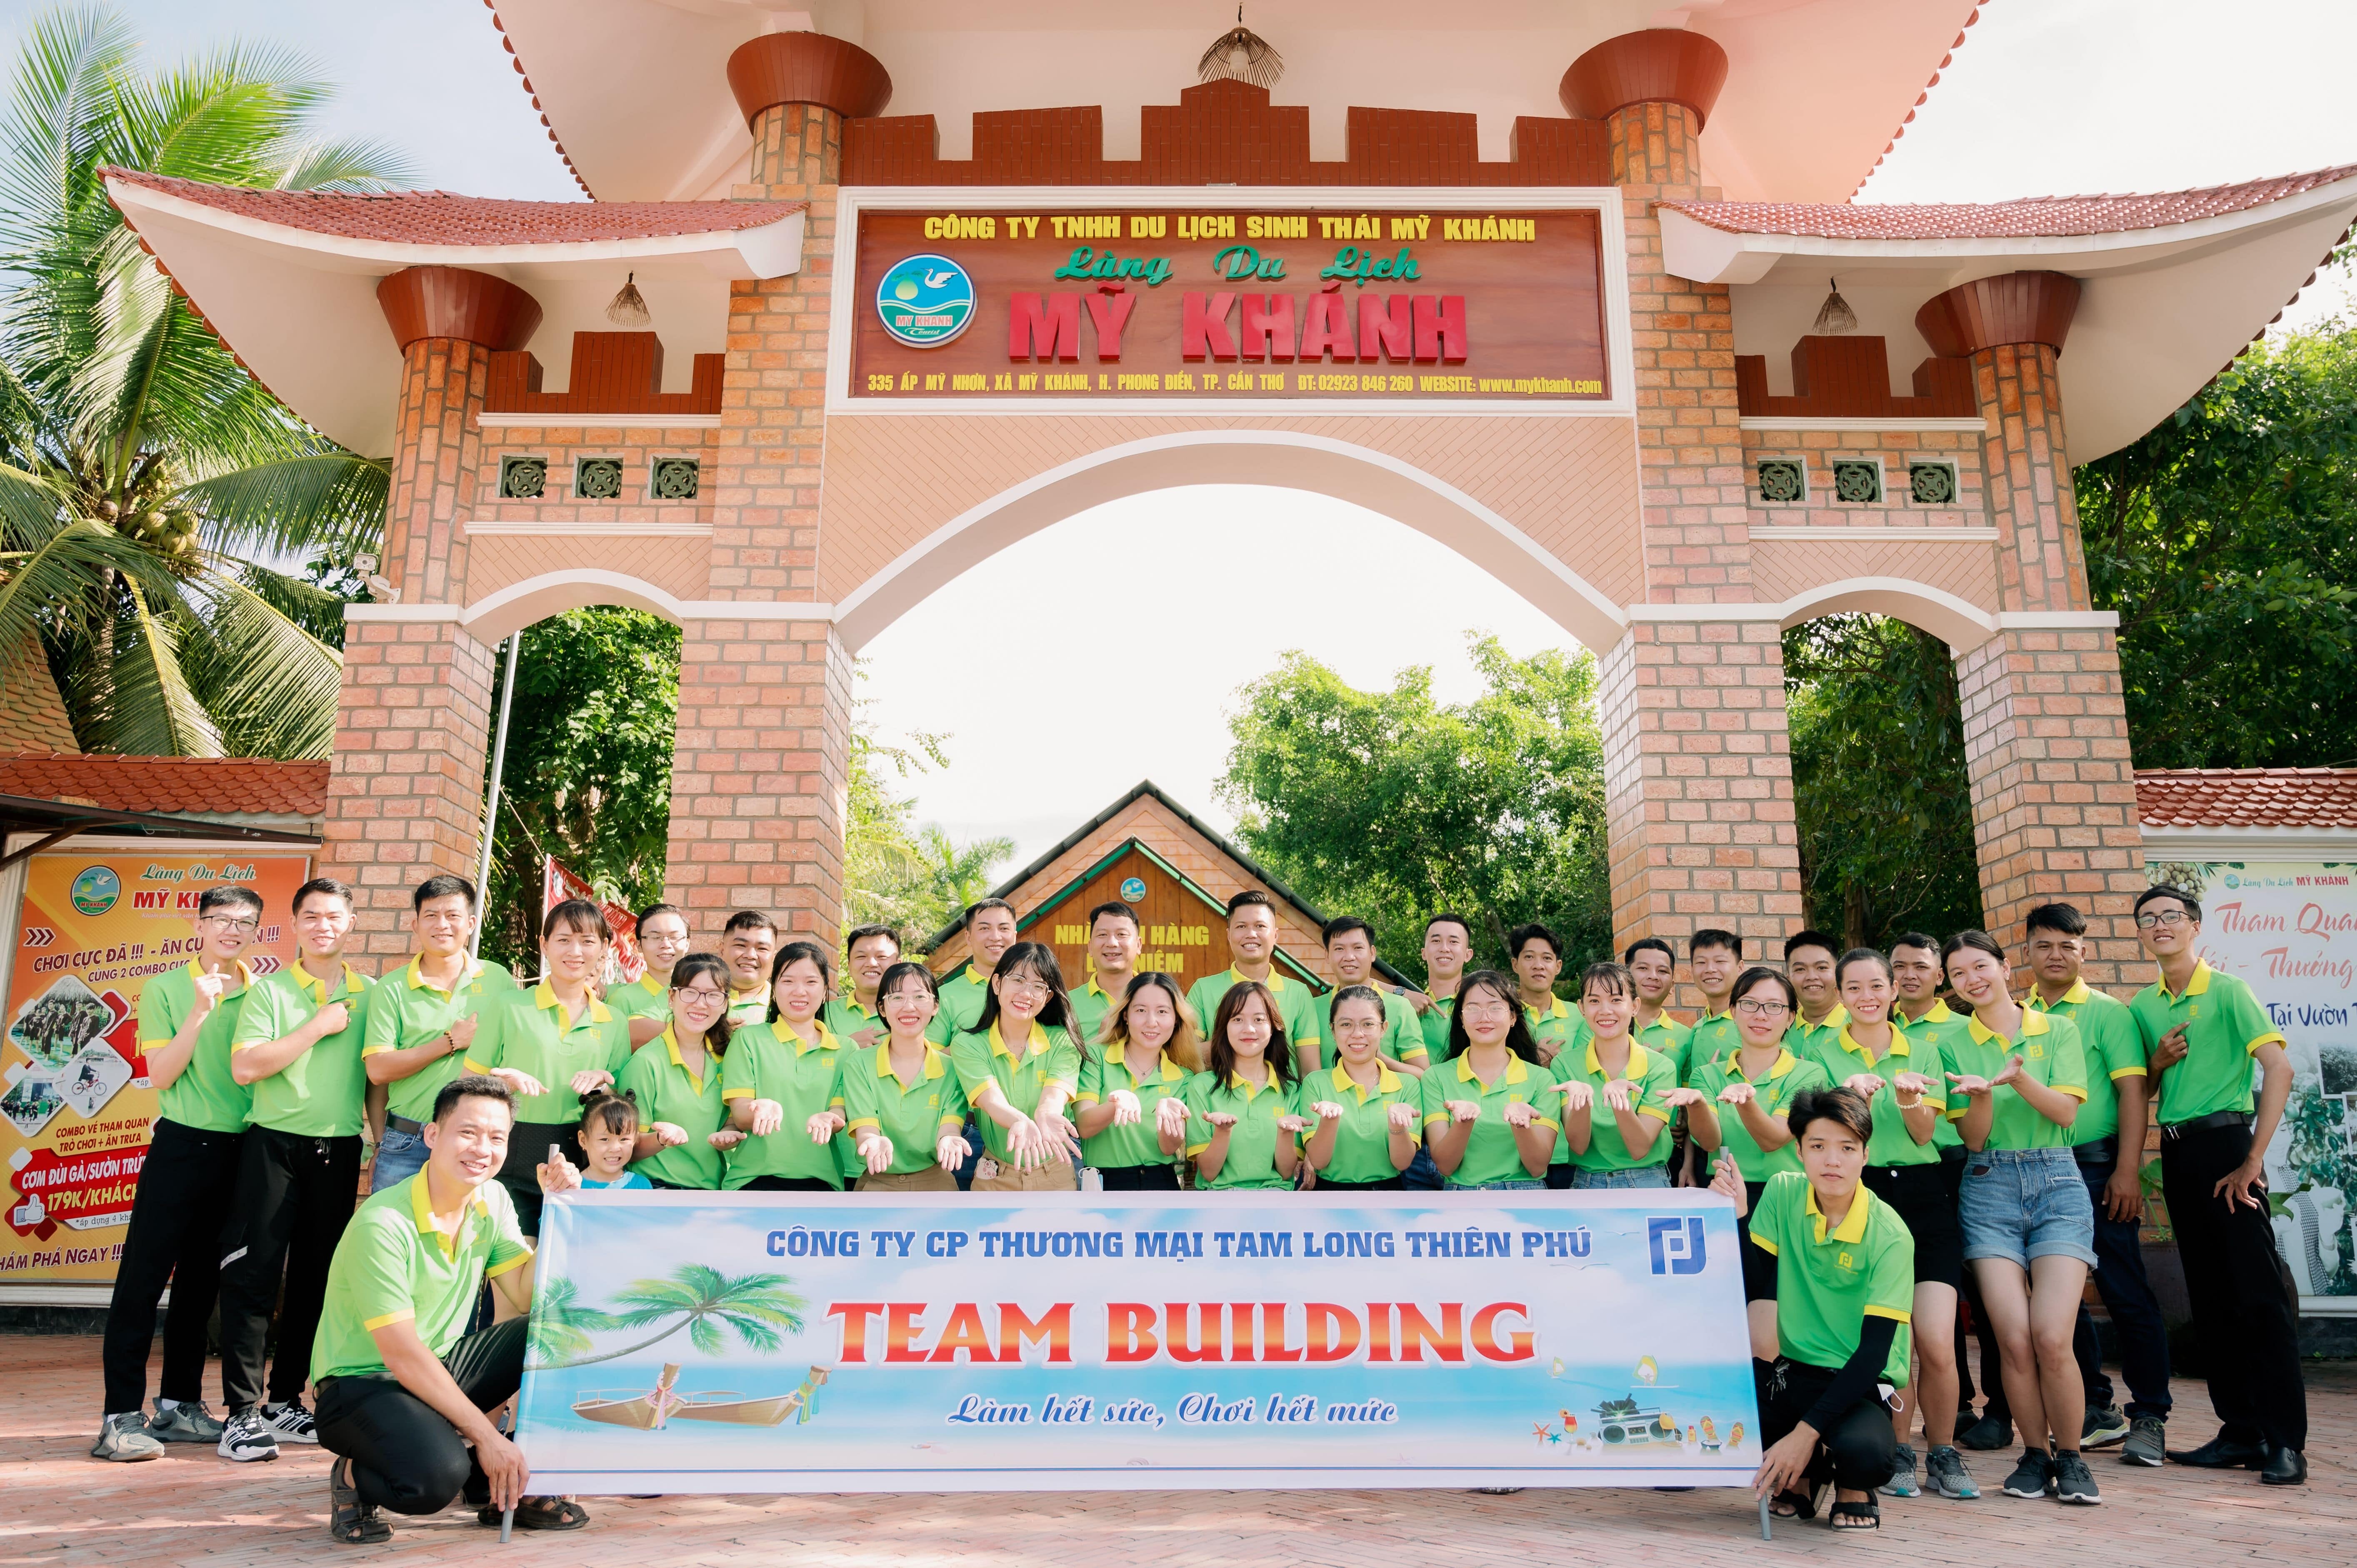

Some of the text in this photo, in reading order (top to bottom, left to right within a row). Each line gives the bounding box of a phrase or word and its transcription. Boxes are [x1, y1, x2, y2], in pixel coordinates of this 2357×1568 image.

[925, 213, 1535, 242] CÔNG TY TNHH DU LỊCH SINH THÁI MỸ KHÁNH
[1054, 245, 1422, 287] Làng Du Lịch
[896, 315, 953, 326] MY KHANH
[1008, 281, 1467, 364] MỸ KHÁNH
[868, 375, 893, 392] 335
[900, 371, 918, 391] ẤP
[925, 373, 946, 391] MỸ
[952, 373, 990, 392] NHƠN,
[995, 372, 1012, 391] XÃ
[1019, 372, 1038, 391] MỸ
[1045, 372, 1092, 392] KHÁNH,
[1099, 374, 1111, 390] H.
[1117, 374, 1159, 391] PHONG
[1165, 370, 1195, 392] ĐIỀN,
[1203, 374, 1222, 391] TP.
[1228, 370, 1253, 391] CẦN
[1260, 372, 1285, 391] THƠ
[1318, 374, 1358, 391] 02923
[1362, 375, 1386, 392] 846
[1389, 375, 1413, 392] 260
[1420, 375, 1476, 392] WEBSITE:
[1479, 377, 1602, 394] www.mykhanh.com
[141, 864, 256, 883] Làng Du Lịch
[133, 889, 170, 908] MỸ
[2215, 901, 2288, 934] Tham
[1151, 921, 1209, 945] HÀNG
[34, 955, 69, 972] CHƠI
[106, 944, 126, 962] ĐÃ
[160, 938, 182, 955] ĂN
[2261, 946, 2357, 989] Thưởng
[88, 968, 117, 982] CÙNG
[120, 969, 126, 978] 2
[129, 963, 167, 977] COMBO
[2266, 1003, 2292, 1031] Tại
[2298, 1003, 2347, 1027] Vườn
[56, 1117, 149, 1138] COMBO VÉ THAM QUAN
[60, 1139, 75, 1152] TRÒ
[77, 1139, 96, 1150] CHƠI
[106, 1133, 118, 1146] ĂN
[120, 1133, 141, 1144] TRƯA
[22, 1170, 46, 1189] CƠM
[49, 1163, 67, 1186] ĐÙI
[767, 1225, 1592, 1262] CÔNG TY CP THƯƠNG MẠI TAM LONG THIÊN PHÚ
[32, 1247, 60, 1268] PHÁ
[65, 1247, 109, 1265] NGAY
[826, 1301, 1537, 1363] TEAM BUILDING
[947, 1395, 1397, 1428] Làm hết sức, Chơi hết mức
